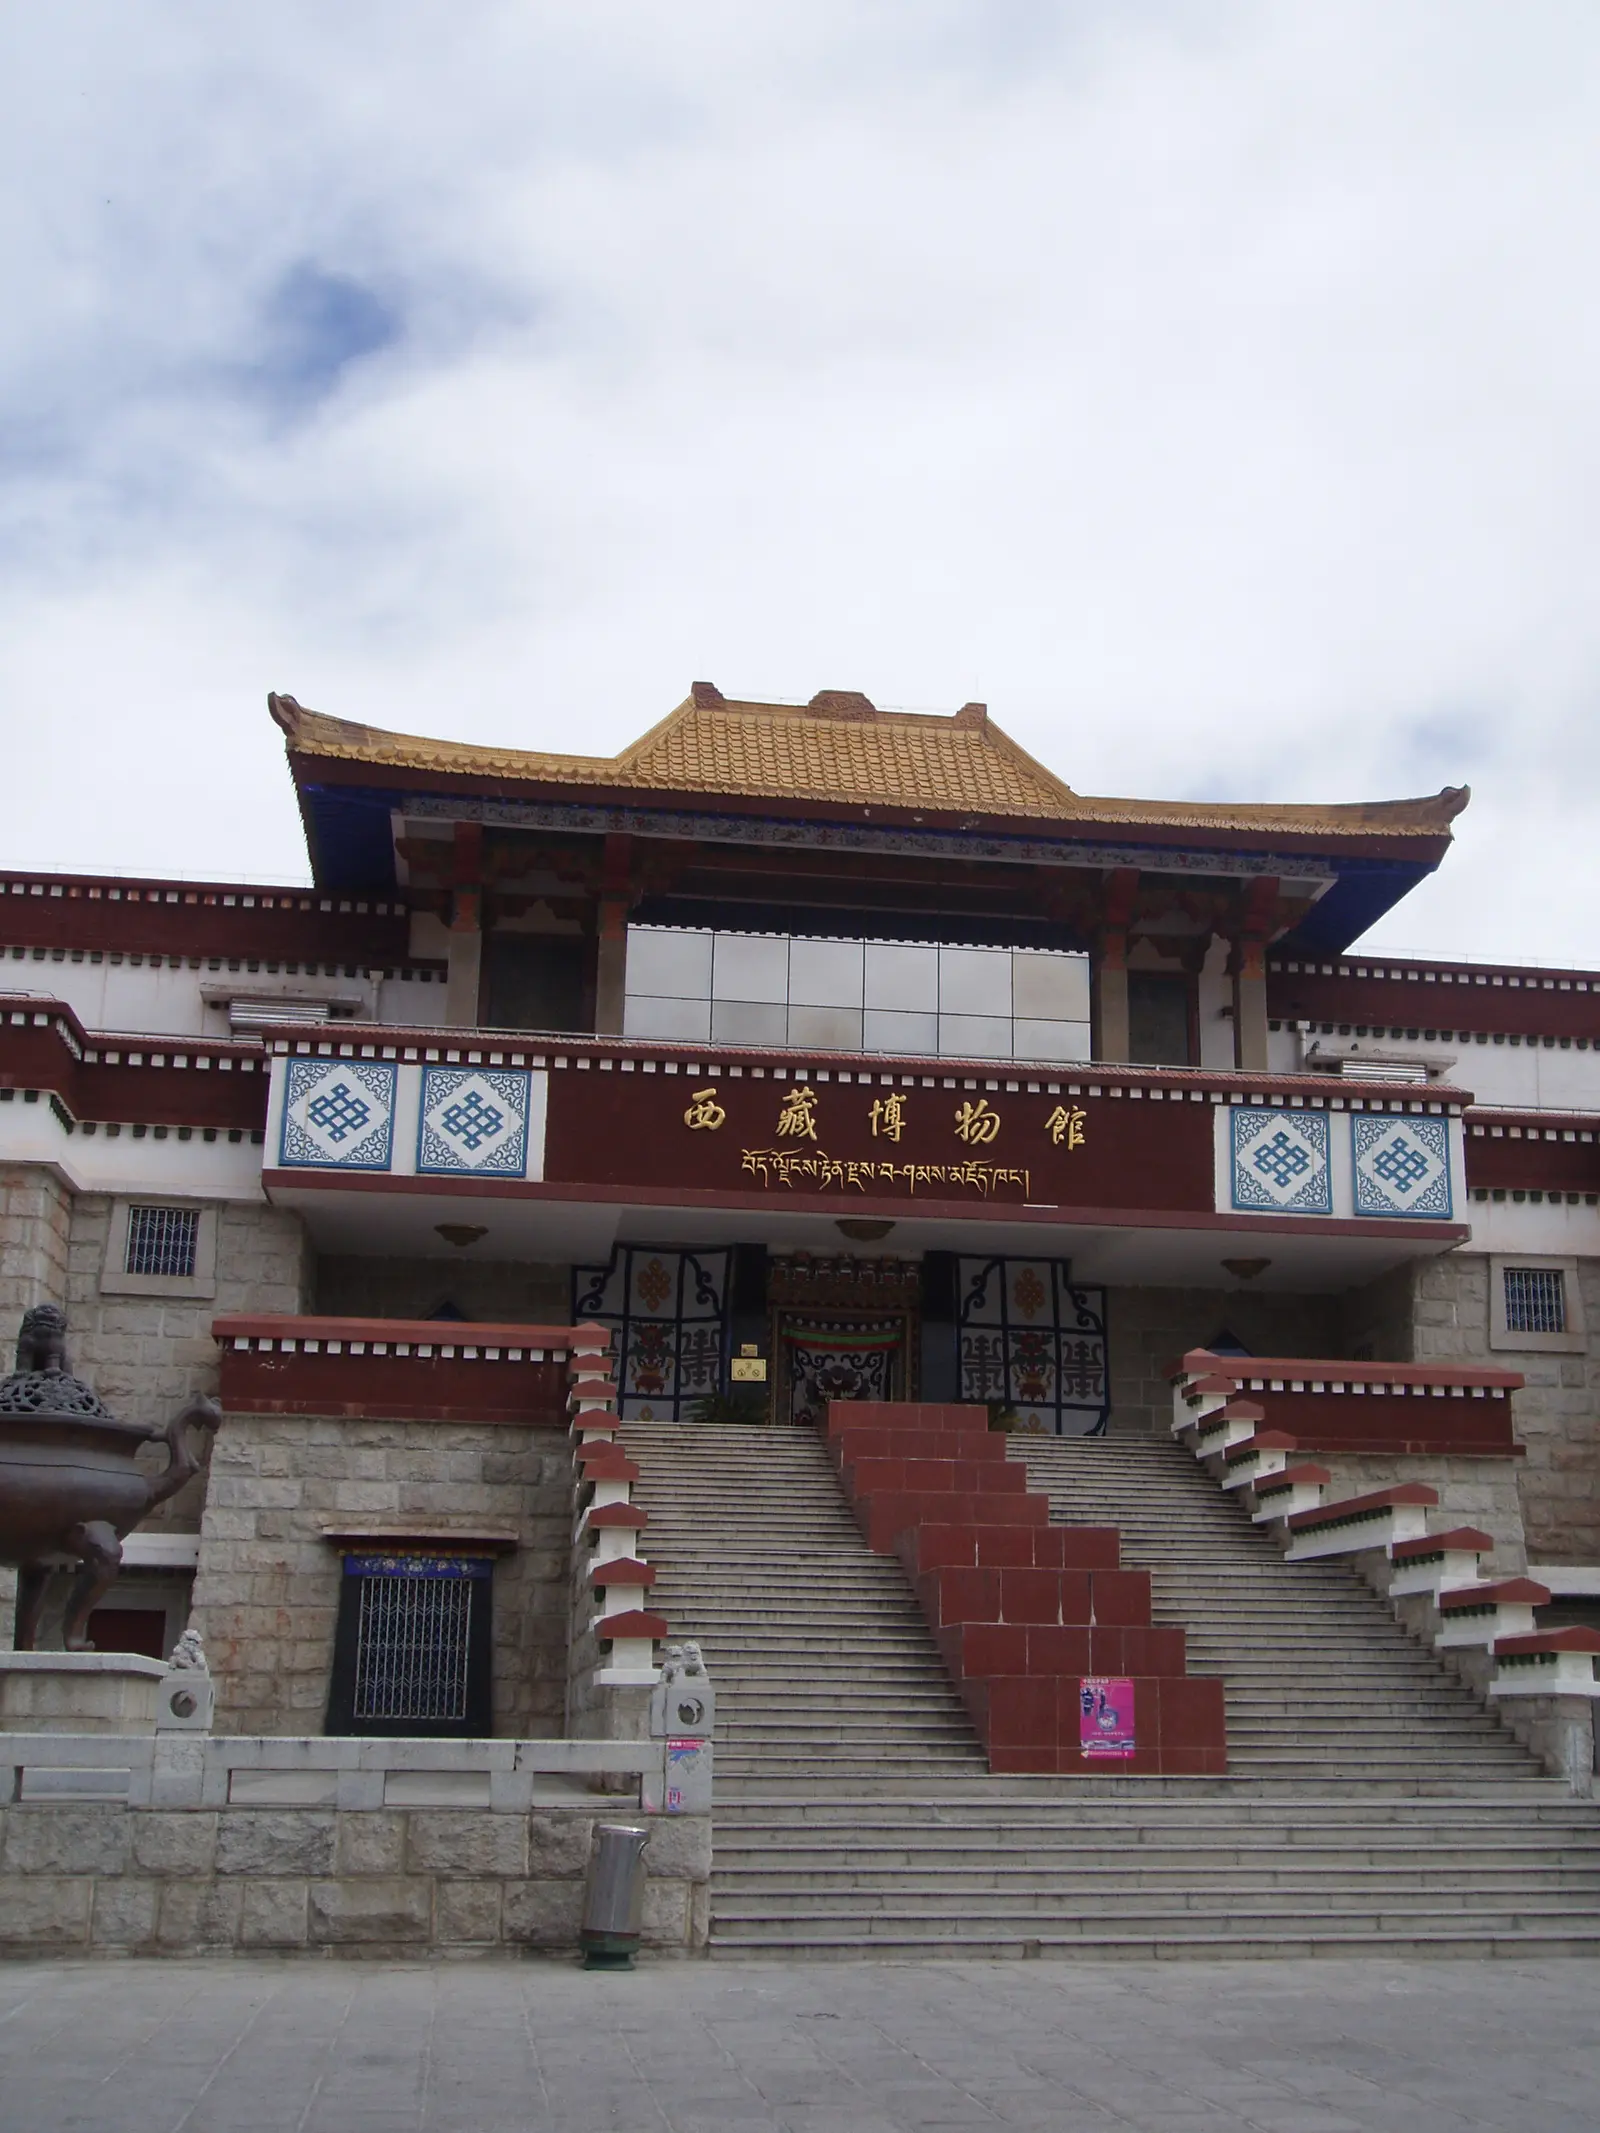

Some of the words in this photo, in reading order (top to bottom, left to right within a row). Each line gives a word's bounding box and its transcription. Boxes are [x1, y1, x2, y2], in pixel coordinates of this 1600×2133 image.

[683, 1086, 1087, 1151] 西藏博物館
